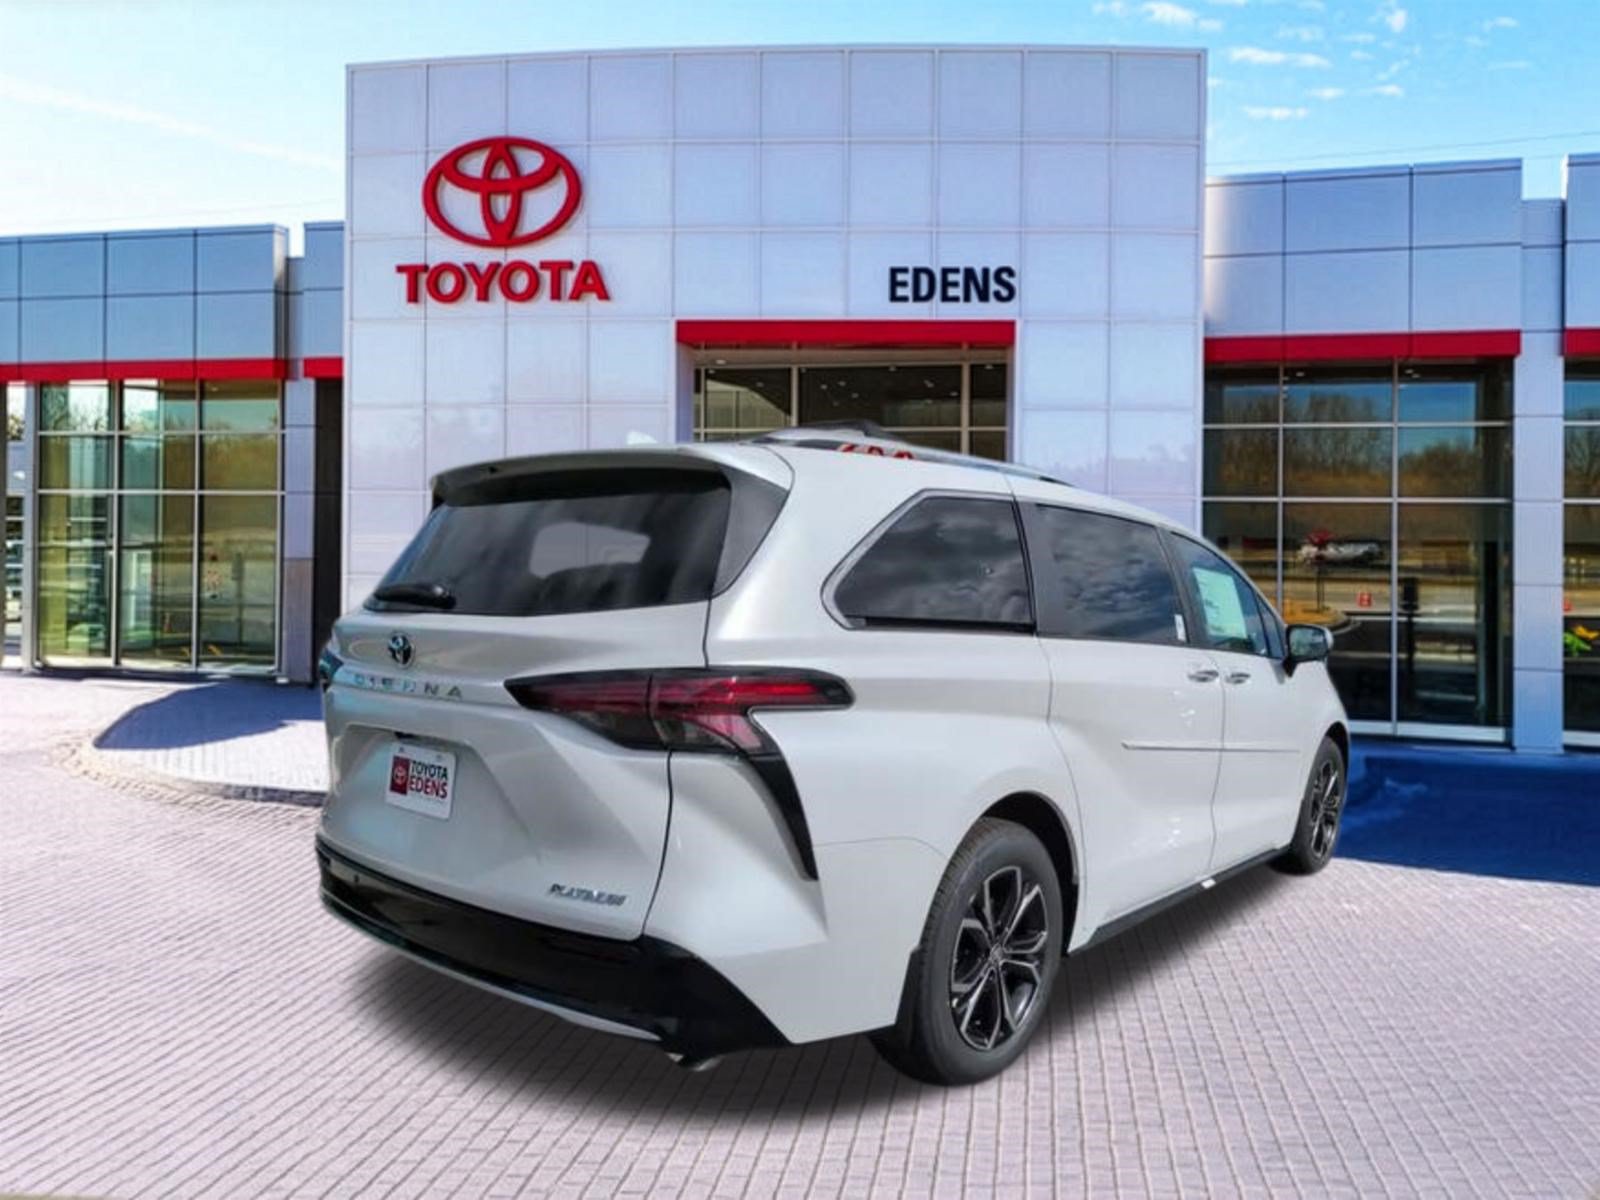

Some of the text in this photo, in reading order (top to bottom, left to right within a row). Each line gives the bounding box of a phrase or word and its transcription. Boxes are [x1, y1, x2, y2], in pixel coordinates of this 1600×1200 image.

[395, 259, 611, 304] TOYOTA
[889, 266, 1017, 303] EDENS
[411, 760, 448, 780] TOYOTA
[409, 776, 448, 799] EDENS
